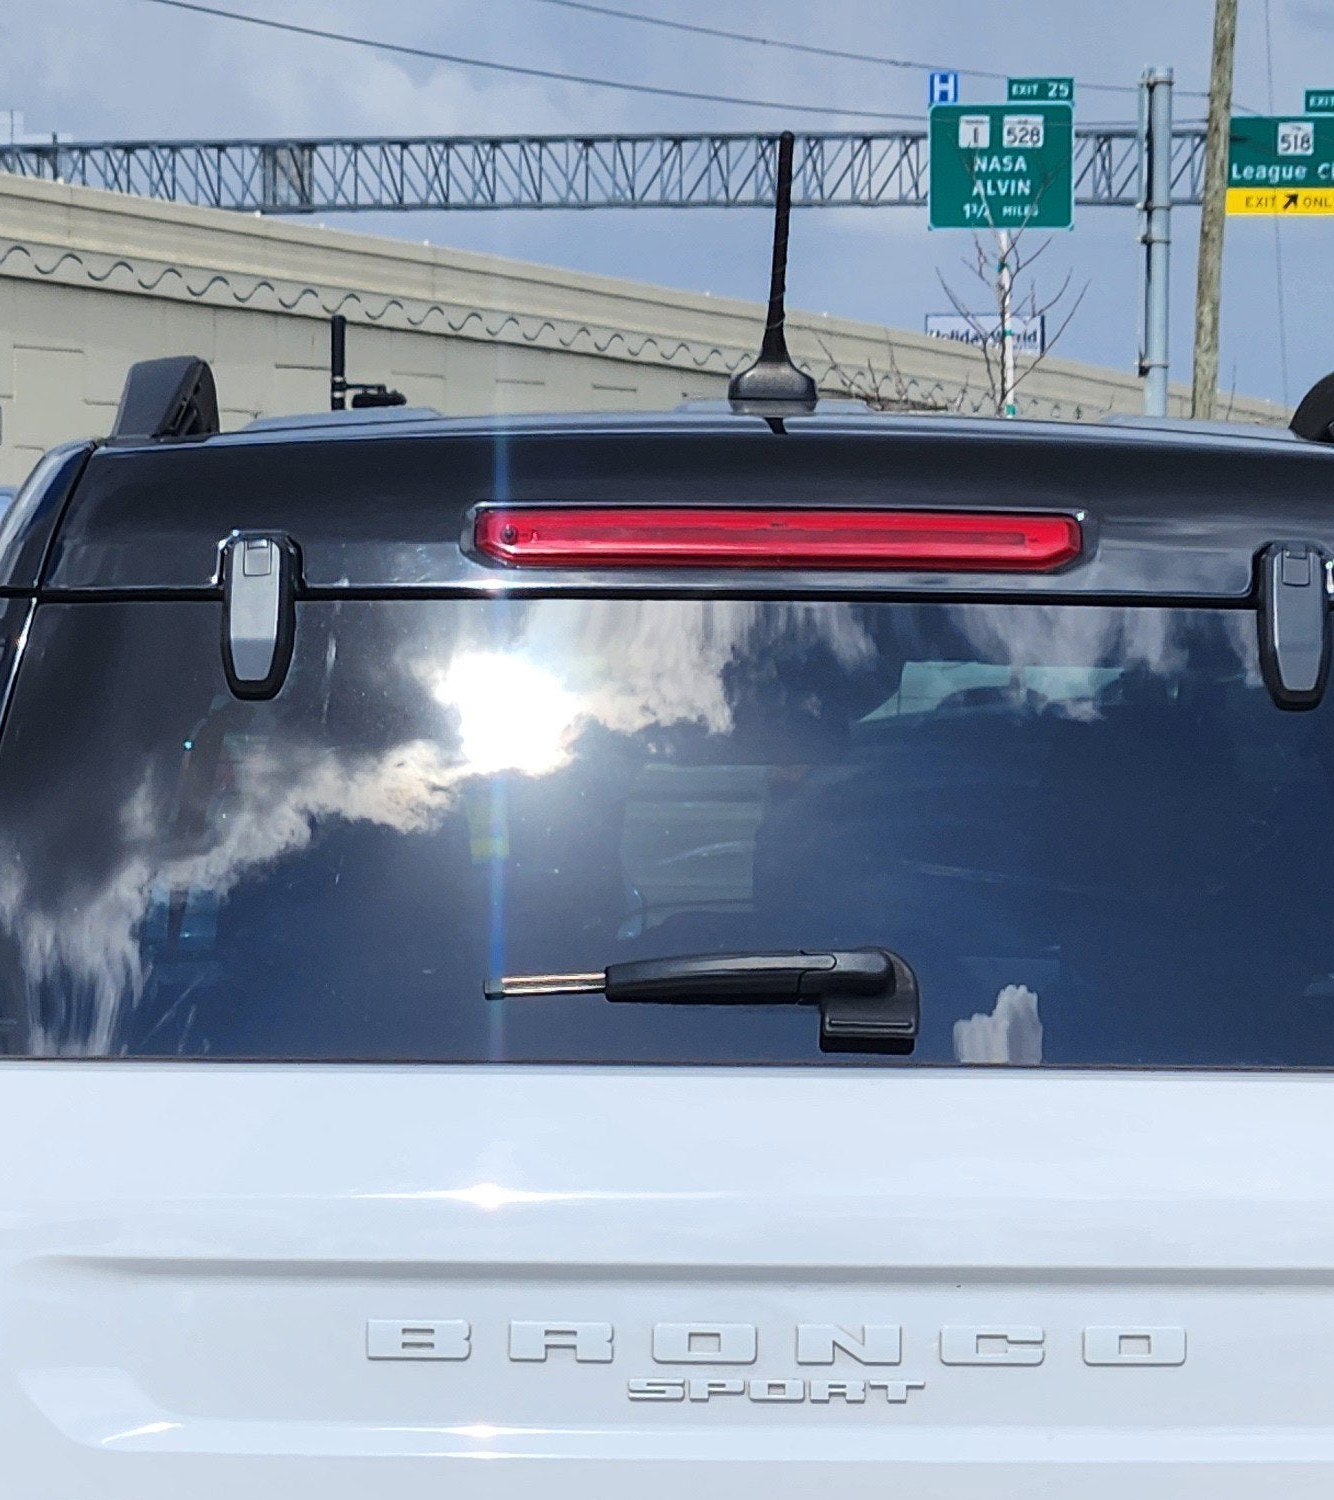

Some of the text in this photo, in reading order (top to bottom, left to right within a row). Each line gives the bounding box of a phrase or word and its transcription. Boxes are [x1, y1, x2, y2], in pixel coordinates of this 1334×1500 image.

[933, 74, 955, 102] H
[1012, 82, 1070, 98] EXIT 25
[1006, 126, 1041, 145] 528
[1280, 133, 1311, 152] 518
[974, 155, 1027, 173] NASA
[1231, 162, 1308, 184] League
[971, 179, 1032, 197] ALVIN
[1245, 195, 1277, 208] EXIT
[1002, 205, 1039, 218] MILES
[366, 1318, 1188, 1367] BRONCO
[627, 1378, 926, 1404] SPORT
